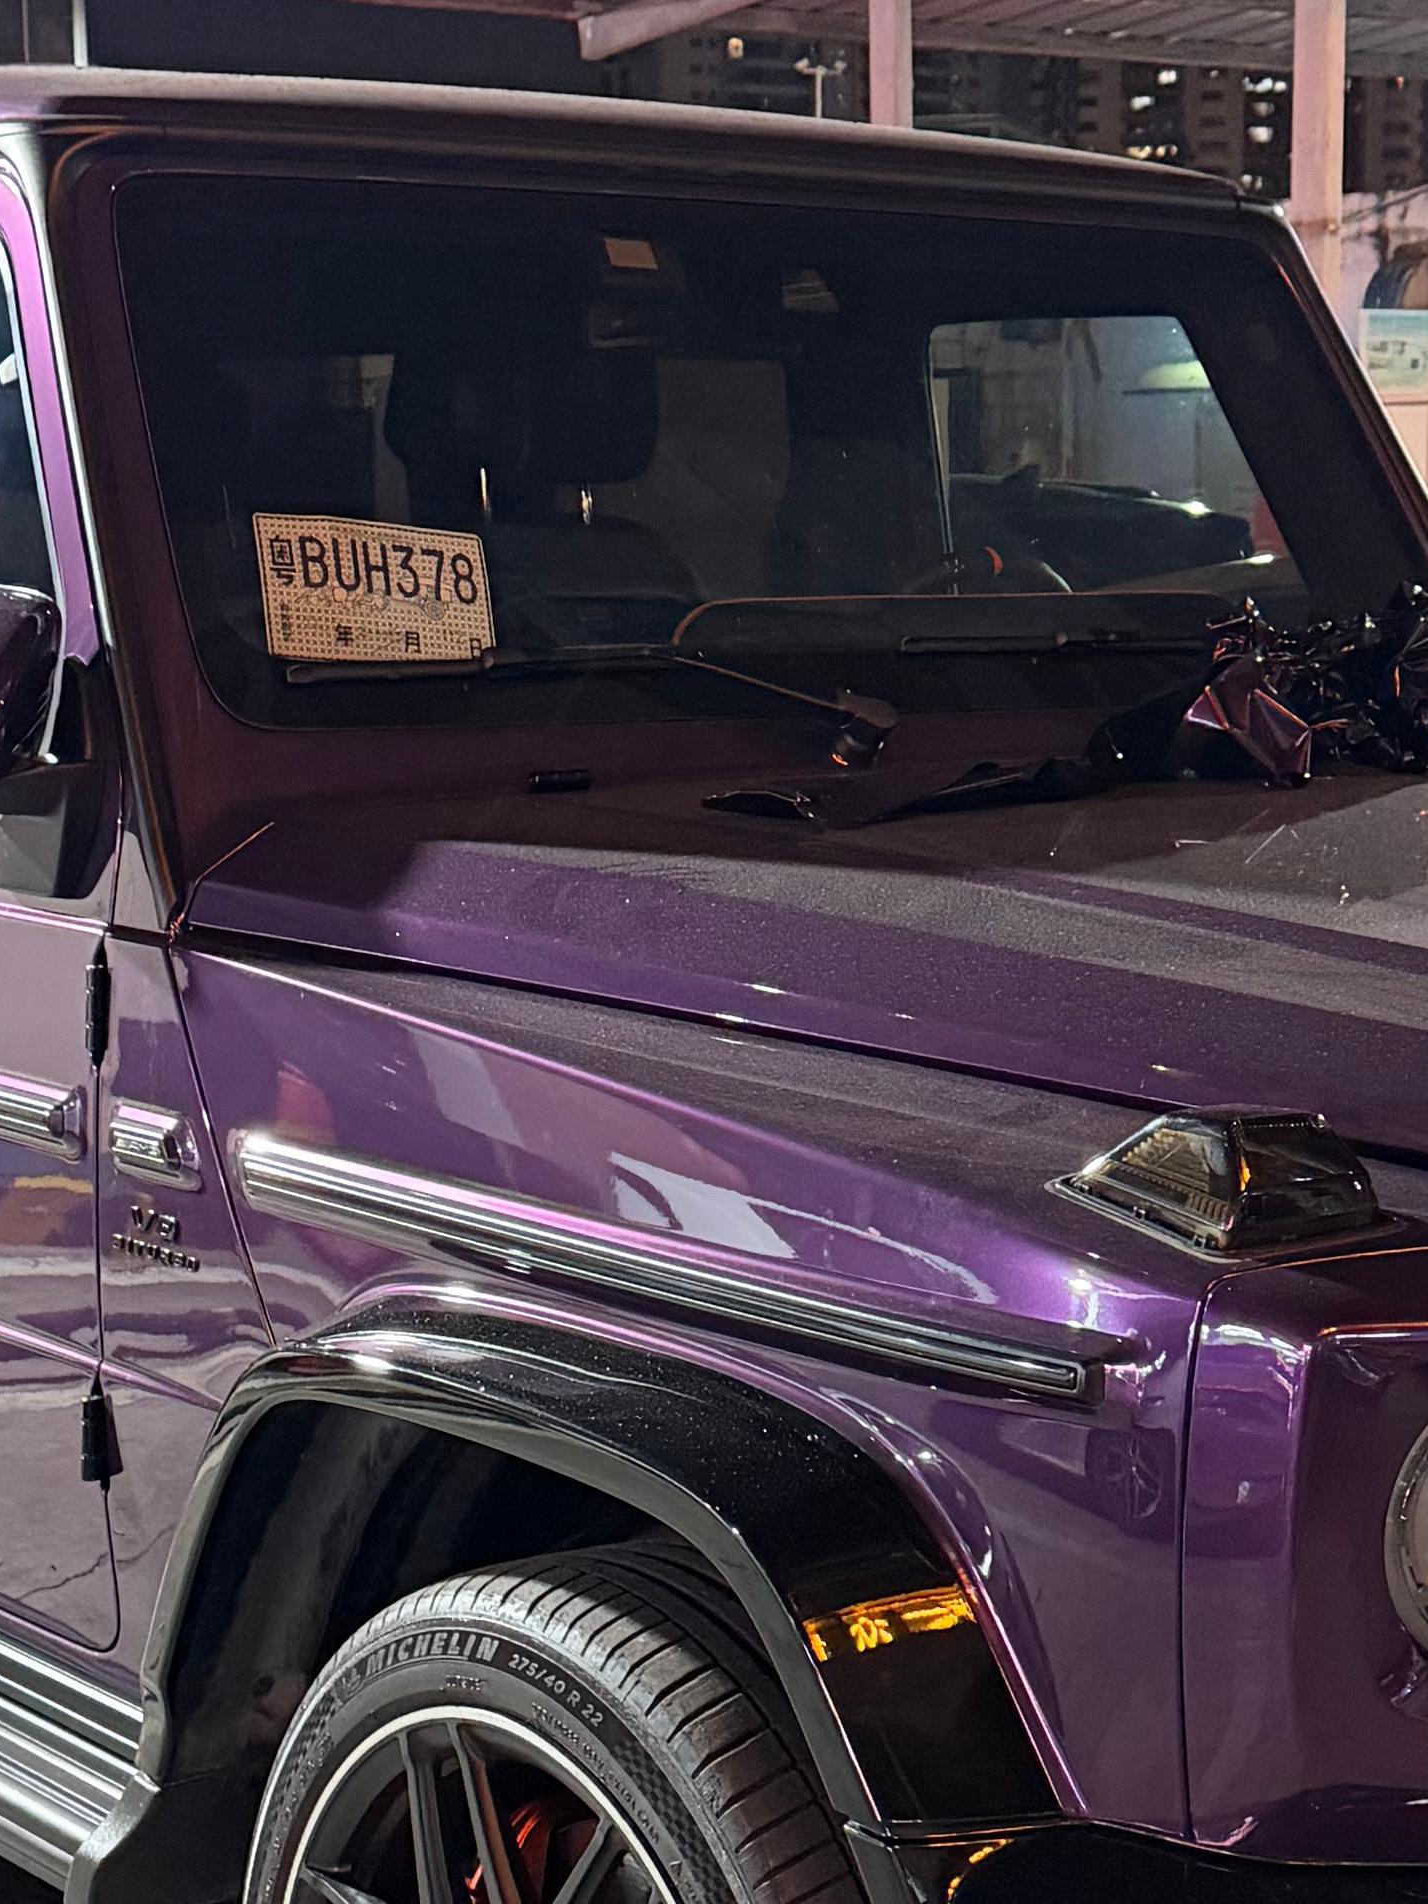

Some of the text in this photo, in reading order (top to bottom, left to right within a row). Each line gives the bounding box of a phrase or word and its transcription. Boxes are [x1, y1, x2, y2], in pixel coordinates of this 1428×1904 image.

[335, 624, 354, 646] 年
[404, 631, 420, 653] 月
[130, 1205, 182, 1243] V8
[366, 1632, 500, 1675] MICHELIN
[508, 1653, 567, 1695] 275/40
[566, 1690, 582, 1709] R
[580, 1702, 606, 1728] 22
